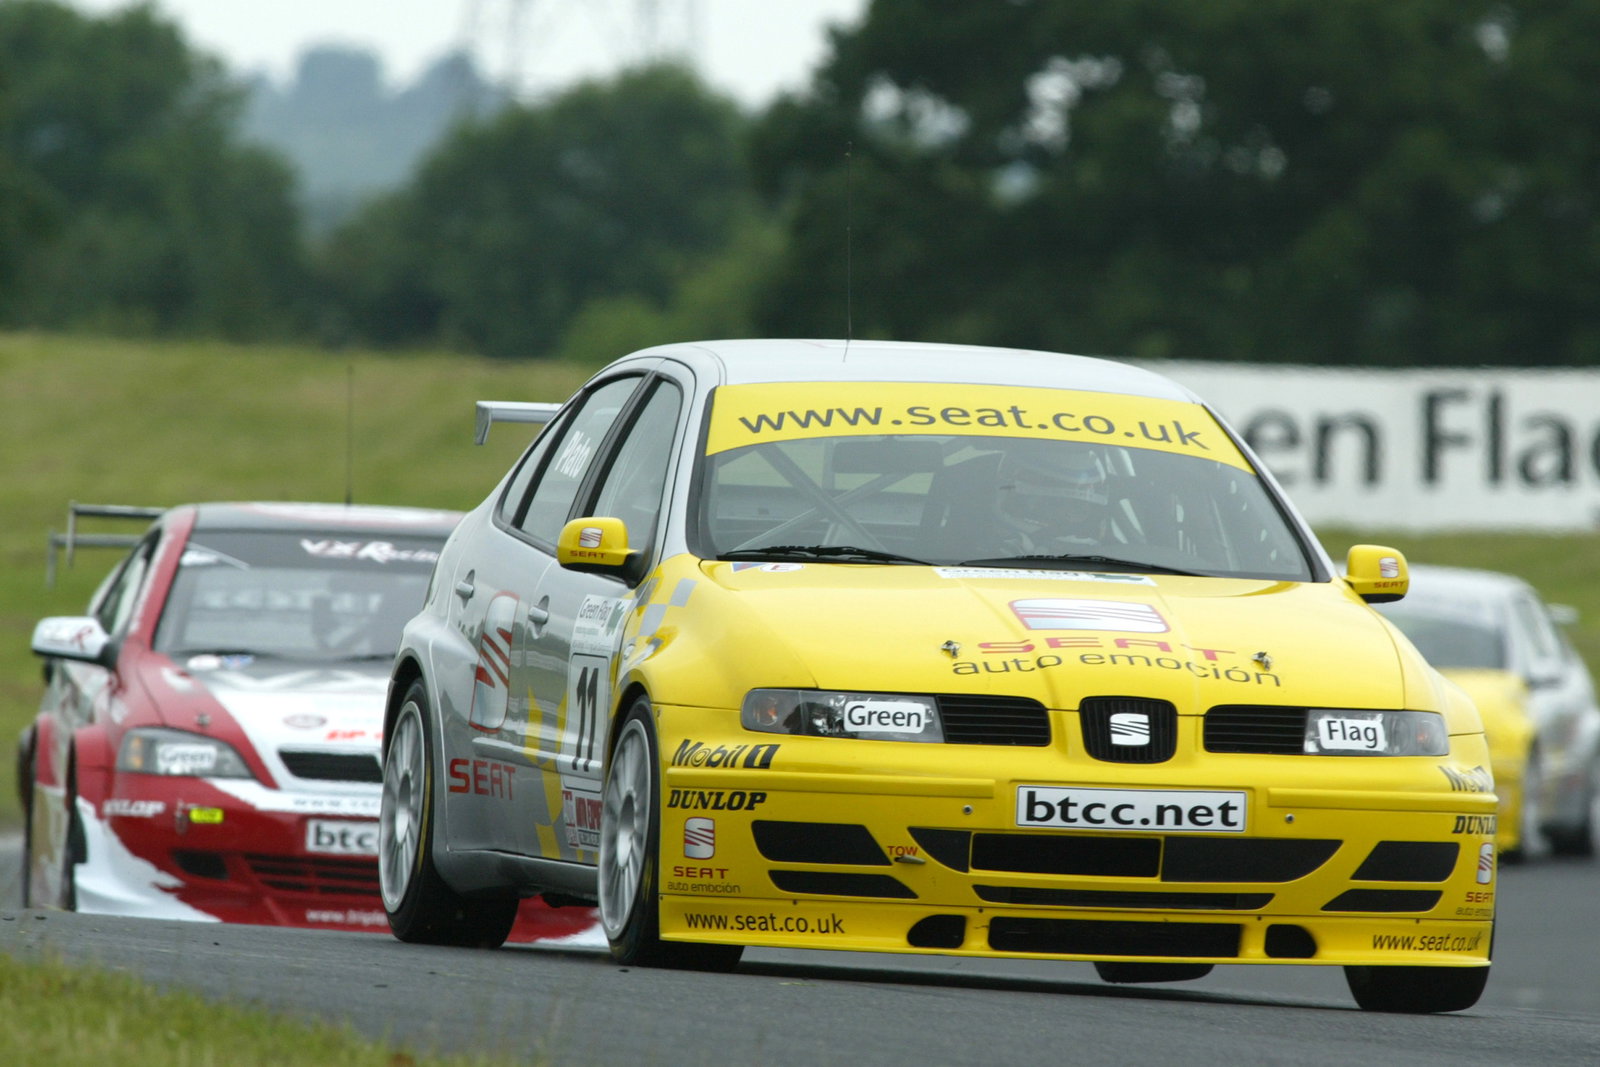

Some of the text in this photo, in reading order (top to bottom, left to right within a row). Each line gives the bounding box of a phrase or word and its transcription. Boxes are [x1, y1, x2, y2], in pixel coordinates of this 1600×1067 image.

[738, 404, 1210, 451] www.seat.co.uk
[554, 429, 591, 479] Plato
[570, 550, 607, 559] SEAT
[1373, 581, 1406, 589] SEAT
[977, 636, 1236, 662] SEAT
[952, 652, 1282, 687] auto emoción
[575, 666, 599, 773] 11
[847, 705, 922, 728] Green
[1326, 720, 1379, 749] Flag
[671, 739, 749, 769] Mobil
[449, 758, 516, 800] SEAT
[667, 789, 767, 811] DUNLOP
[1026, 791, 1239, 828] btcc.net
[887, 845, 919, 857] TOW
[673, 866, 730, 879] SEAT
[667, 880, 741, 893] auto emoción
[684, 912, 846, 934] www.seat.co.uk
[1371, 931, 1483, 952] www.seat.co.uk
